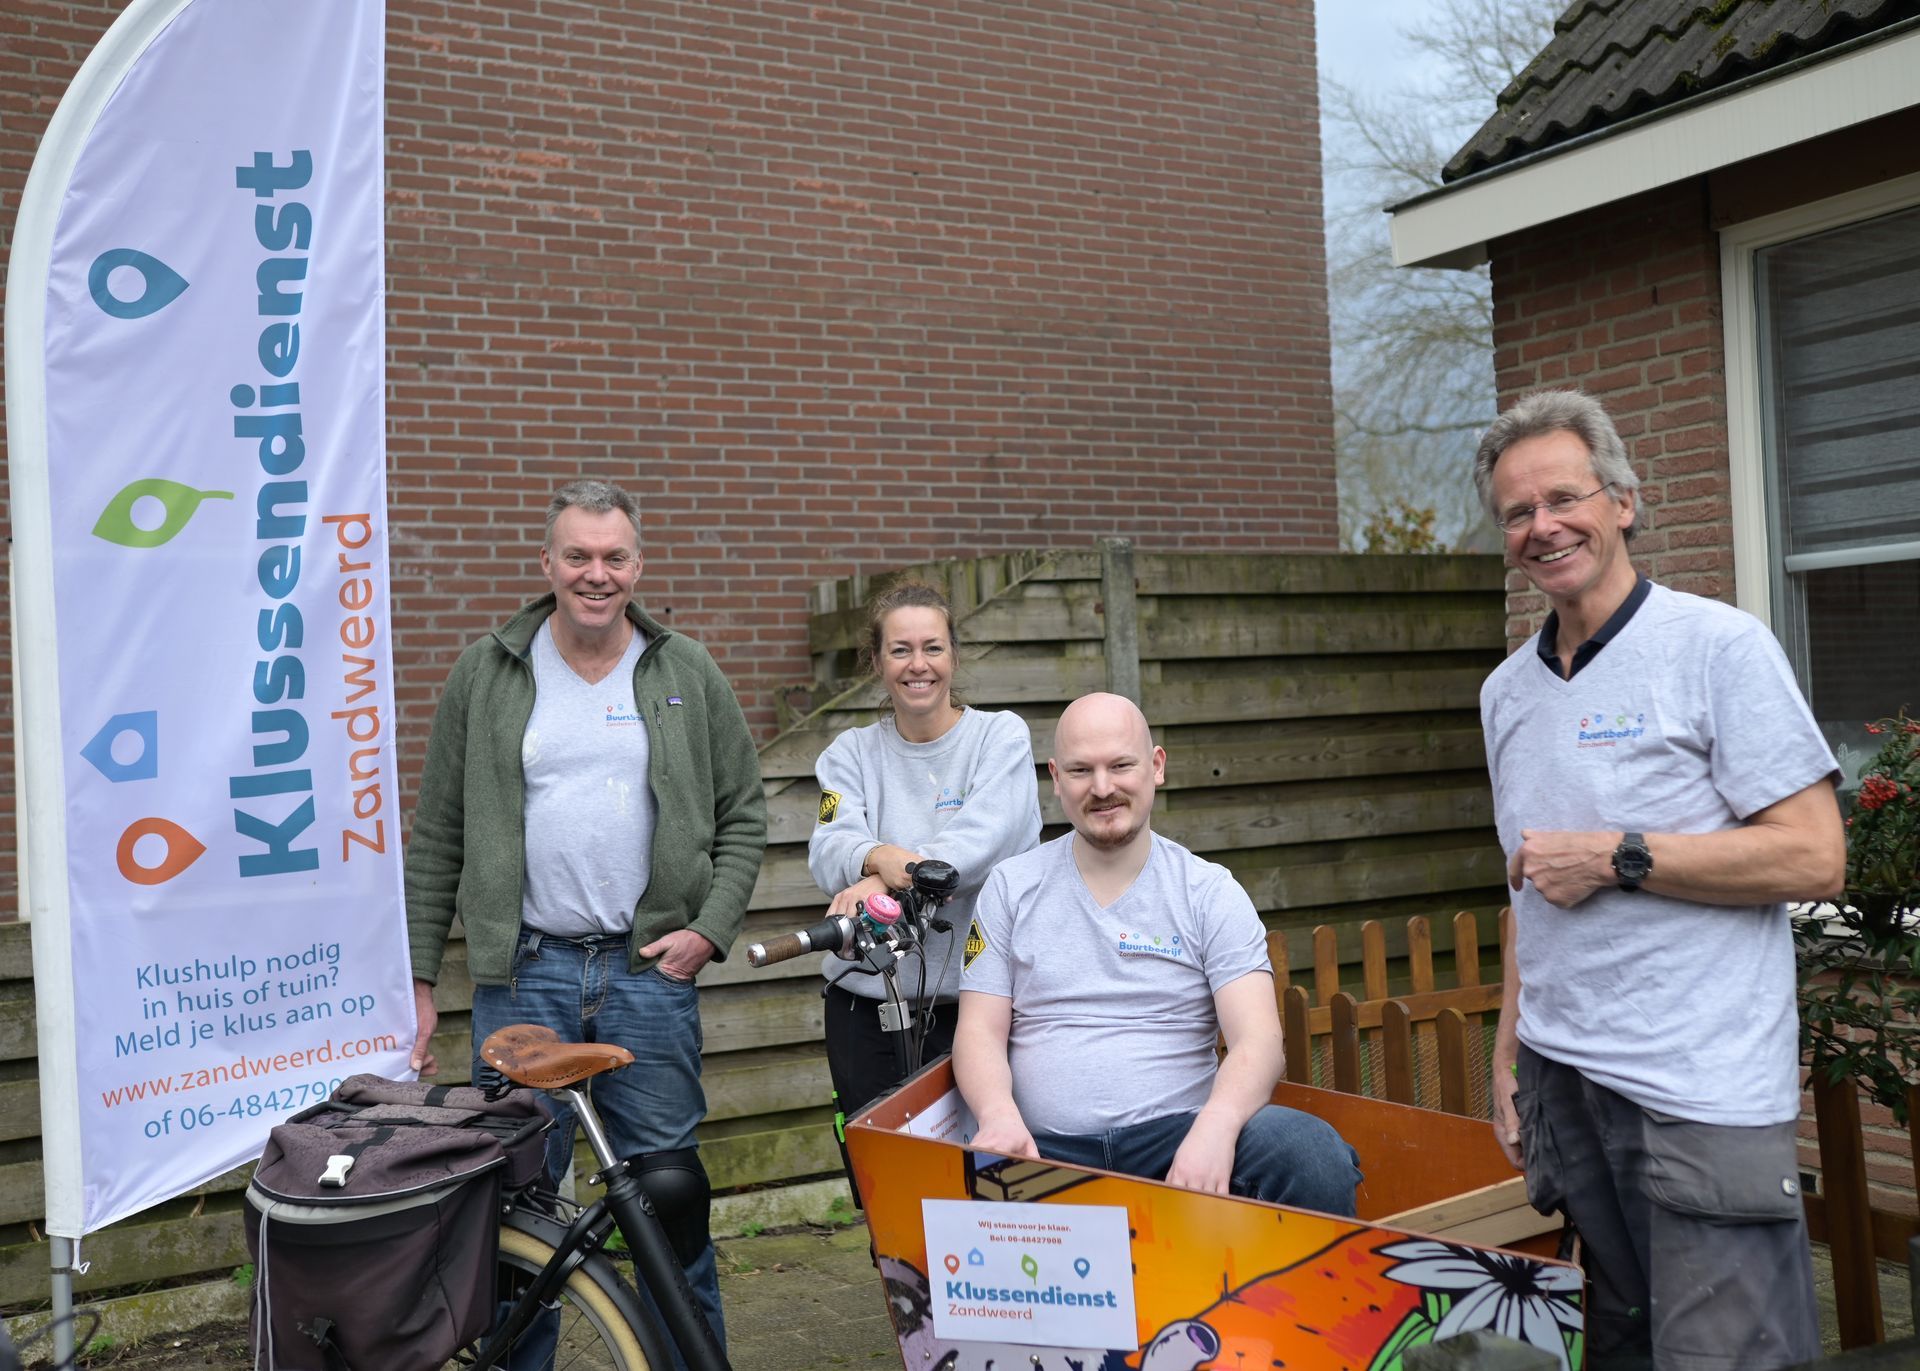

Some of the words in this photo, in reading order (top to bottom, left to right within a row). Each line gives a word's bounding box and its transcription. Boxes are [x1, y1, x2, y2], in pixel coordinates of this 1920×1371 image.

[229, 149, 320, 878] Klussendienst
[321, 512, 386, 863] Zandweerd
[136, 954, 257, 989] Klushulp
[266, 943, 341, 974] nodig
[1119, 941, 1182, 957] Buurtbedrijf
[143, 998, 167, 1020] in
[177, 988, 234, 1014] huis
[243, 981, 272, 1005] of
[278, 966, 339, 998] tuin?
[115, 1022, 181, 1058] Meld
[189, 1020, 214, 1049] je
[223, 1014, 277, 1037] klus
[286, 1001, 332, 1025] aan
[341, 993, 375, 1017] op
[101, 1034, 397, 1109] www.zandweerd.com
[144, 1110, 174, 1139] of
[978, 1220, 992, 1230] Wij
[993, 1222, 1017, 1230] staan
[1038, 1223, 1046, 1232] je
[1047, 1224, 1072, 1232] klaar.
[989, 1234, 1006, 1242] Bel:
[946, 1281, 1117, 1308] Klussendienst
[948, 1304, 1033, 1320] Zandweerd
